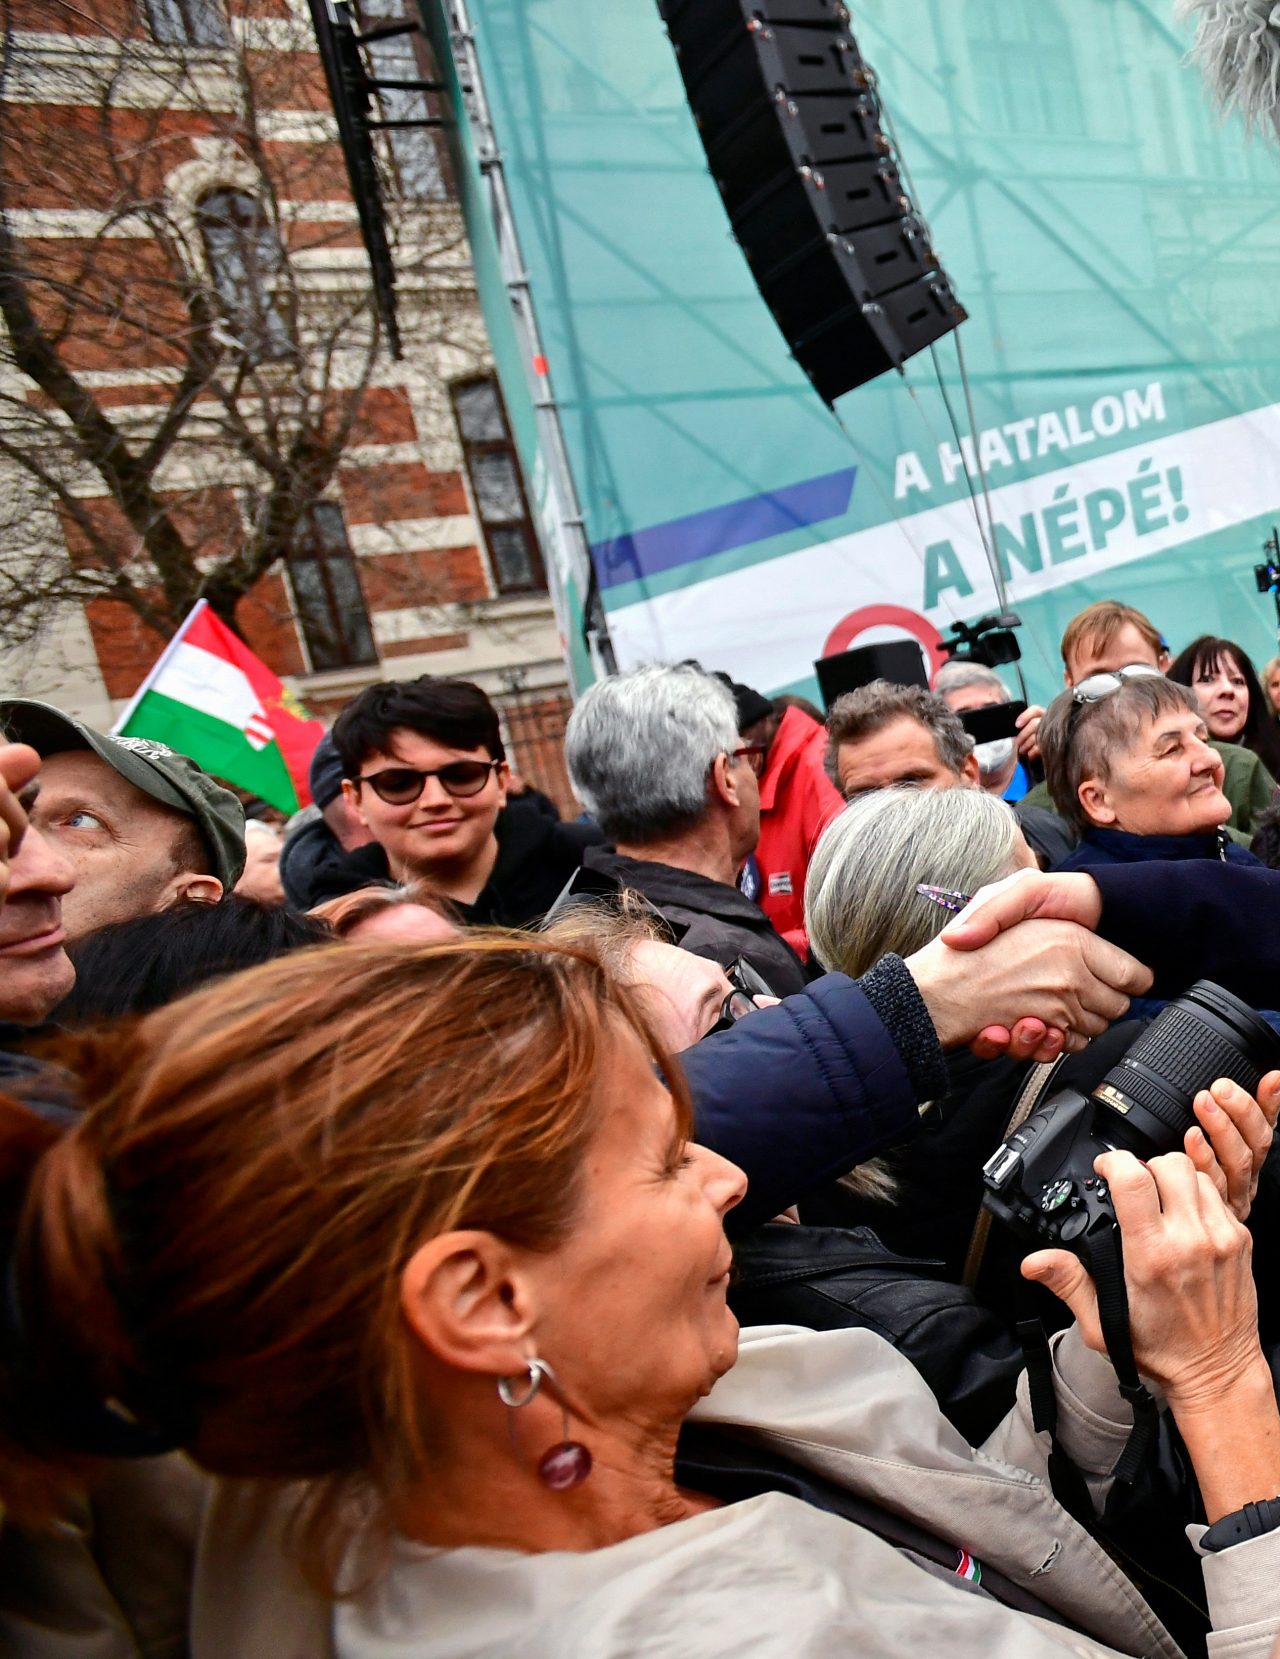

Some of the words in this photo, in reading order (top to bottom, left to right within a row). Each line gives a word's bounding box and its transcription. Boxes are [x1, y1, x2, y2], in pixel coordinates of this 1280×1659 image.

[894, 452, 931, 498] A
[938, 382, 1166, 484] HATALOM
[923, 539, 974, 610] A
[991, 457, 1189, 583] NÉPÉ!
